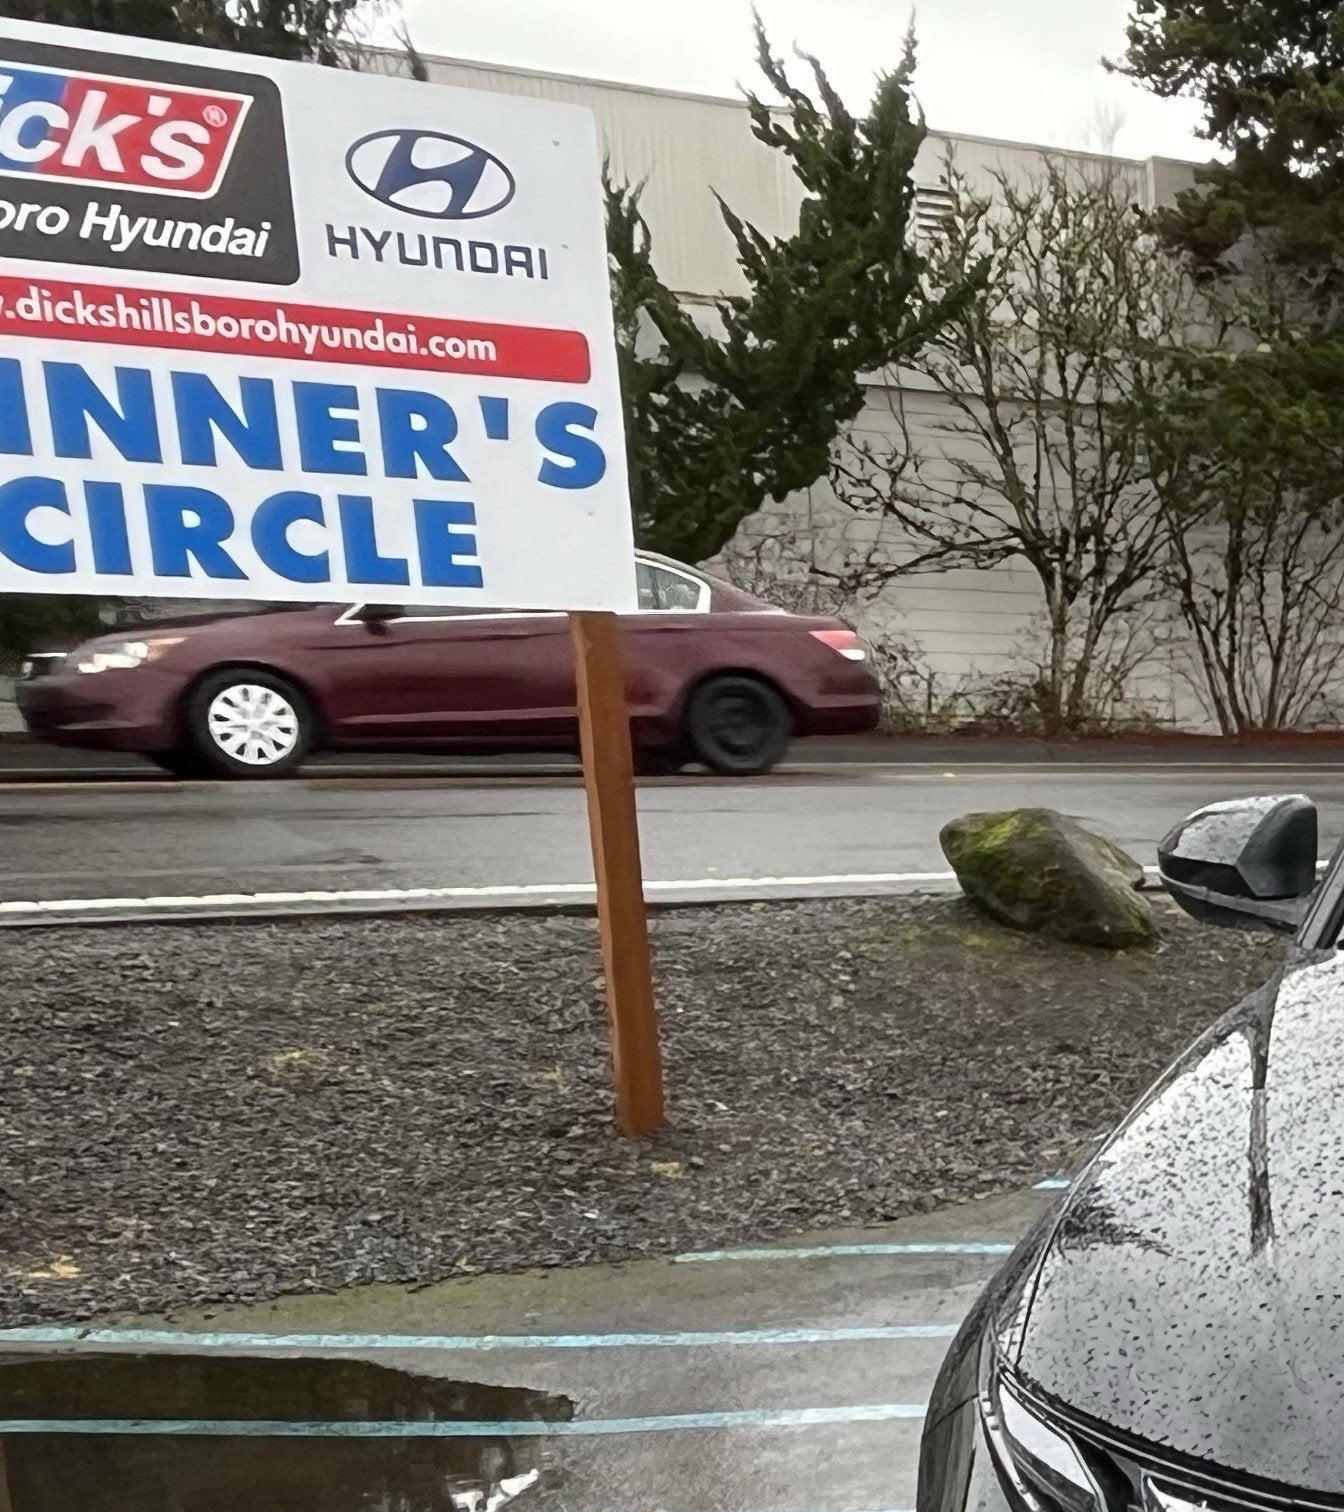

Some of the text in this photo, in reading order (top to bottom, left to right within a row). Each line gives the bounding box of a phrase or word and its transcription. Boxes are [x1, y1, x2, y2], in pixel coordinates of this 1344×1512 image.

[0, 74, 211, 181] ck's
[79, 201, 272, 258] Hyundai
[325, 223, 548, 281] HYUNDAI
[0, 285, 497, 361] .dickshillsborohyundai.com
[0, 476, 484, 589] CIRCLE
